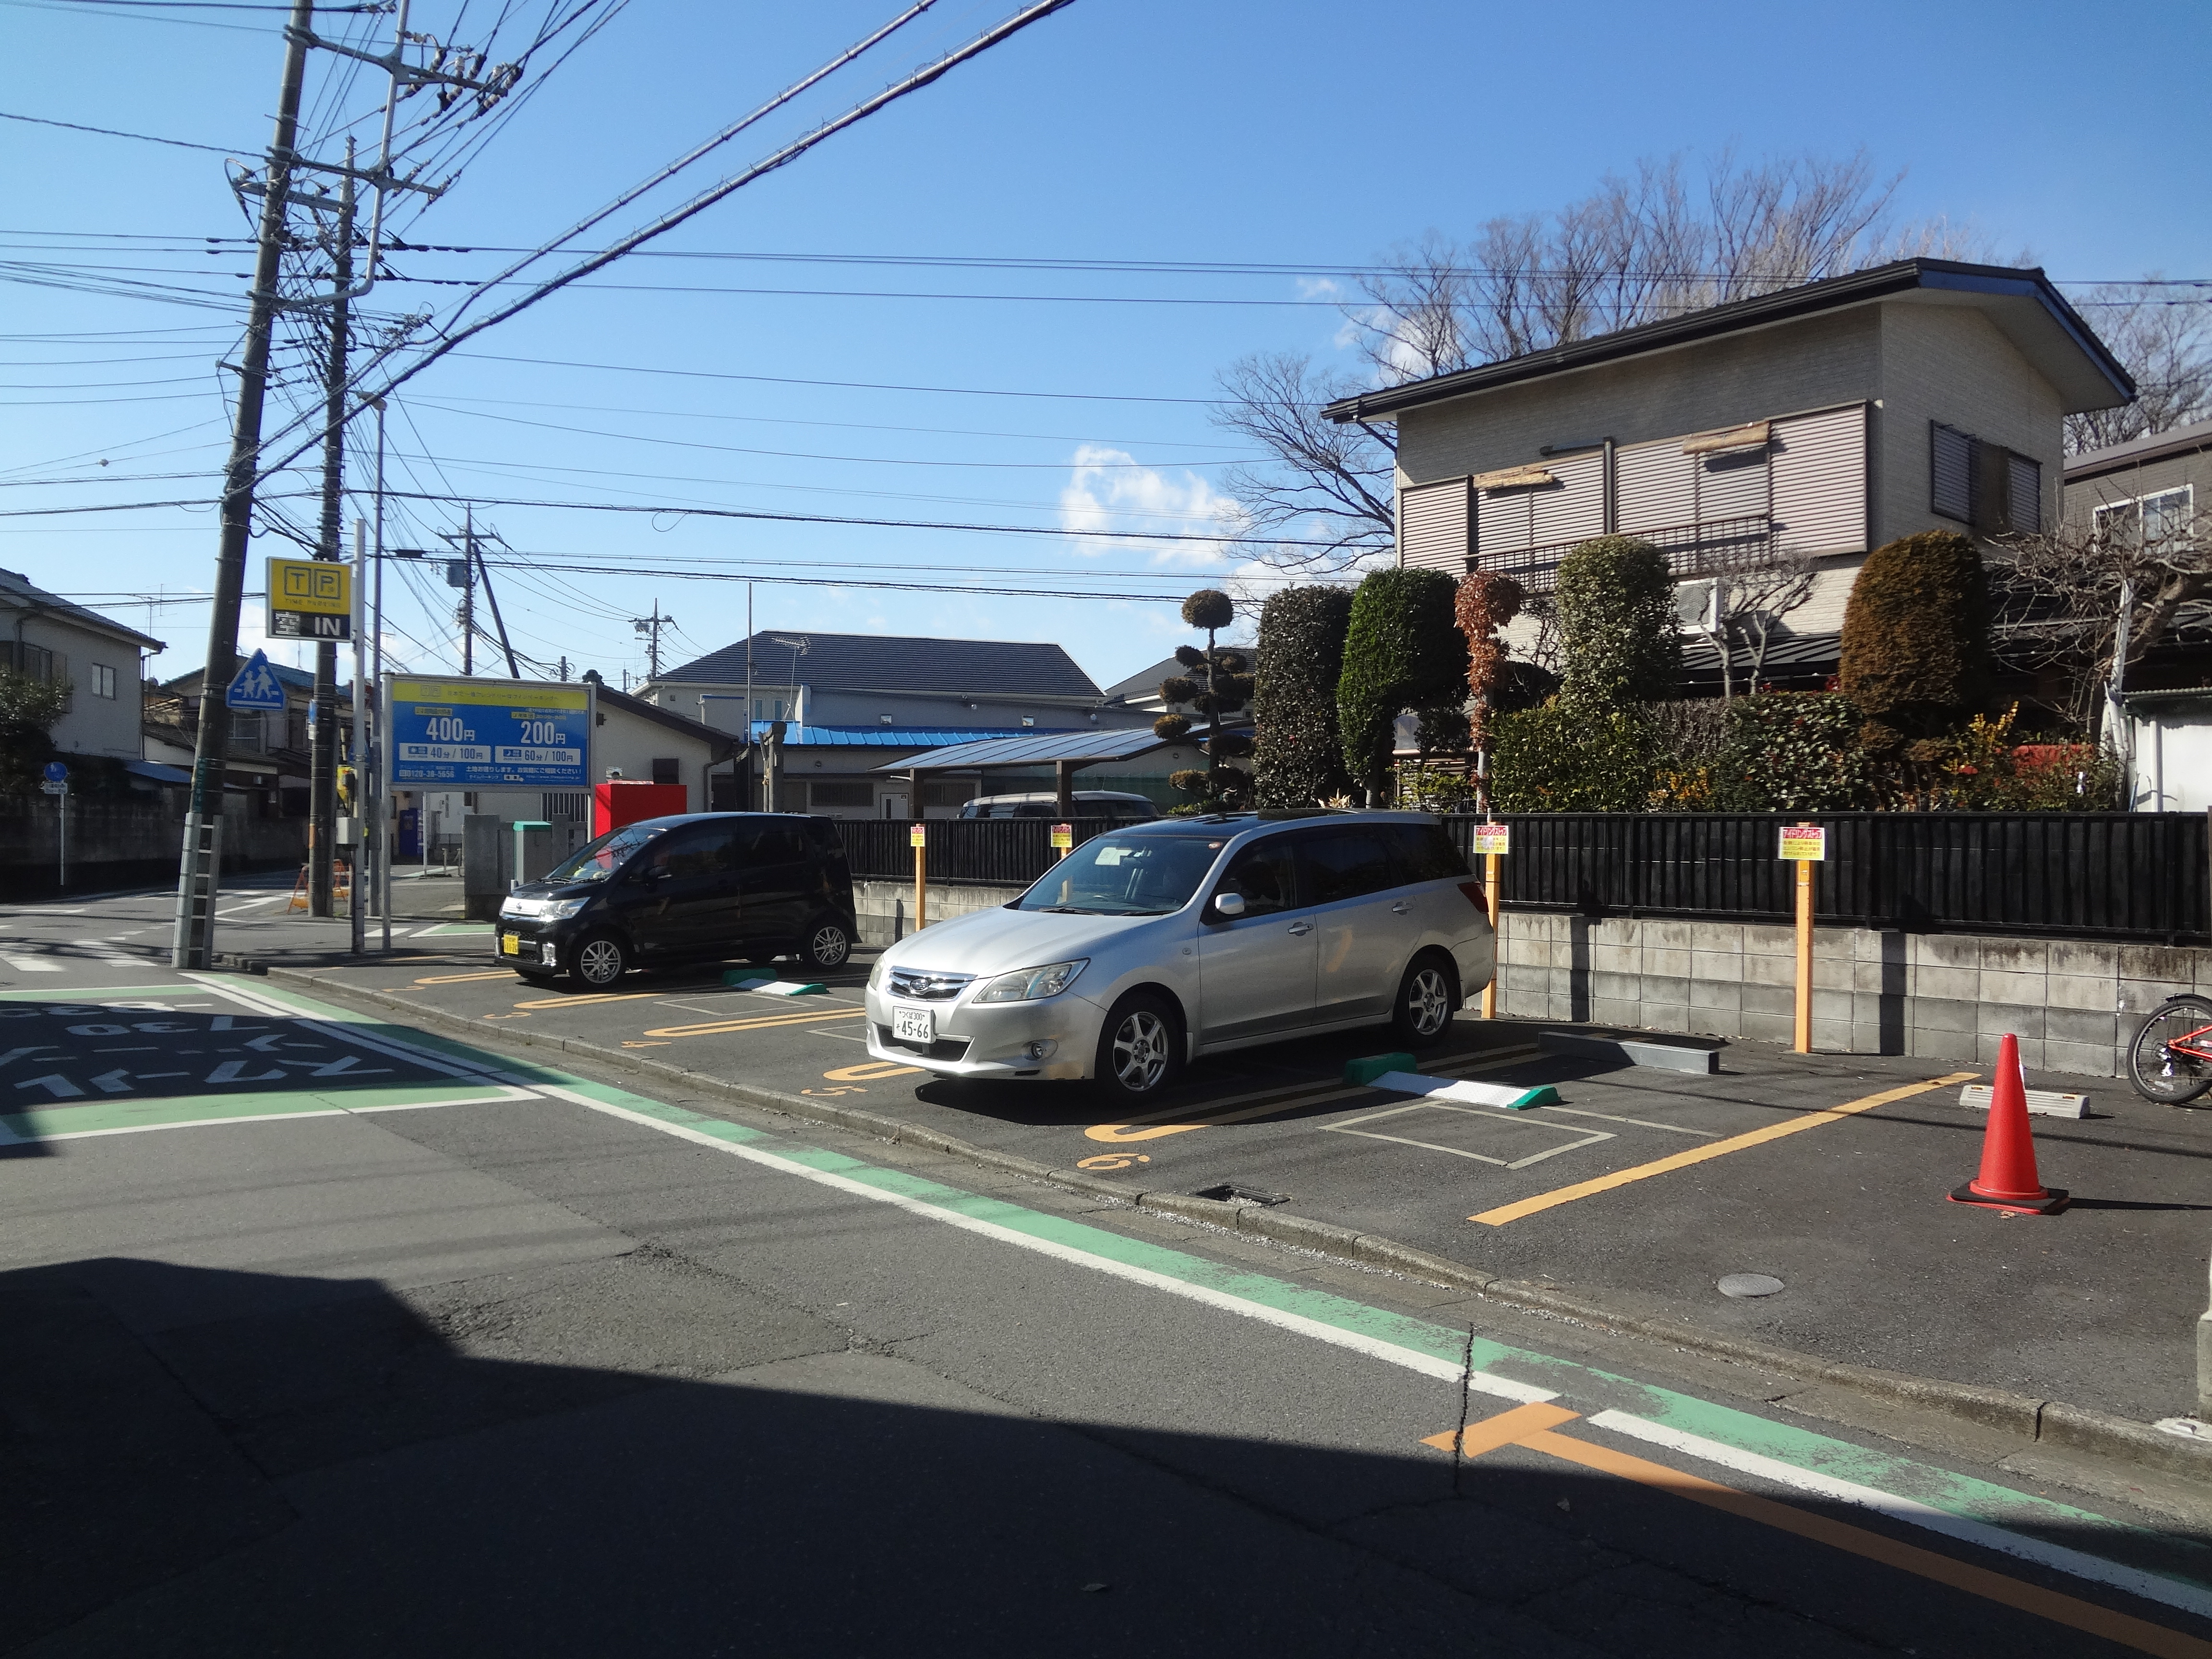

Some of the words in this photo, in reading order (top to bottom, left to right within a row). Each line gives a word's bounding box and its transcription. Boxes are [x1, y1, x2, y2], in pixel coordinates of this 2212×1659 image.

[314, 616, 341, 636] IN
[426, 717, 476, 741] 400円
[520, 721, 566, 745] 200円
[1476, 827, 1506, 836] アイドリングストップ
[1783, 829, 1822, 839] アイドリングストップ
[902, 1021, 929, 1039] 45-66
[620, 1040, 673, 1048] 4
[13, 1055, 395, 1098] スクール
[800, 1085, 869, 1096] 5
[1076, 1153, 1150, 1170] 6
